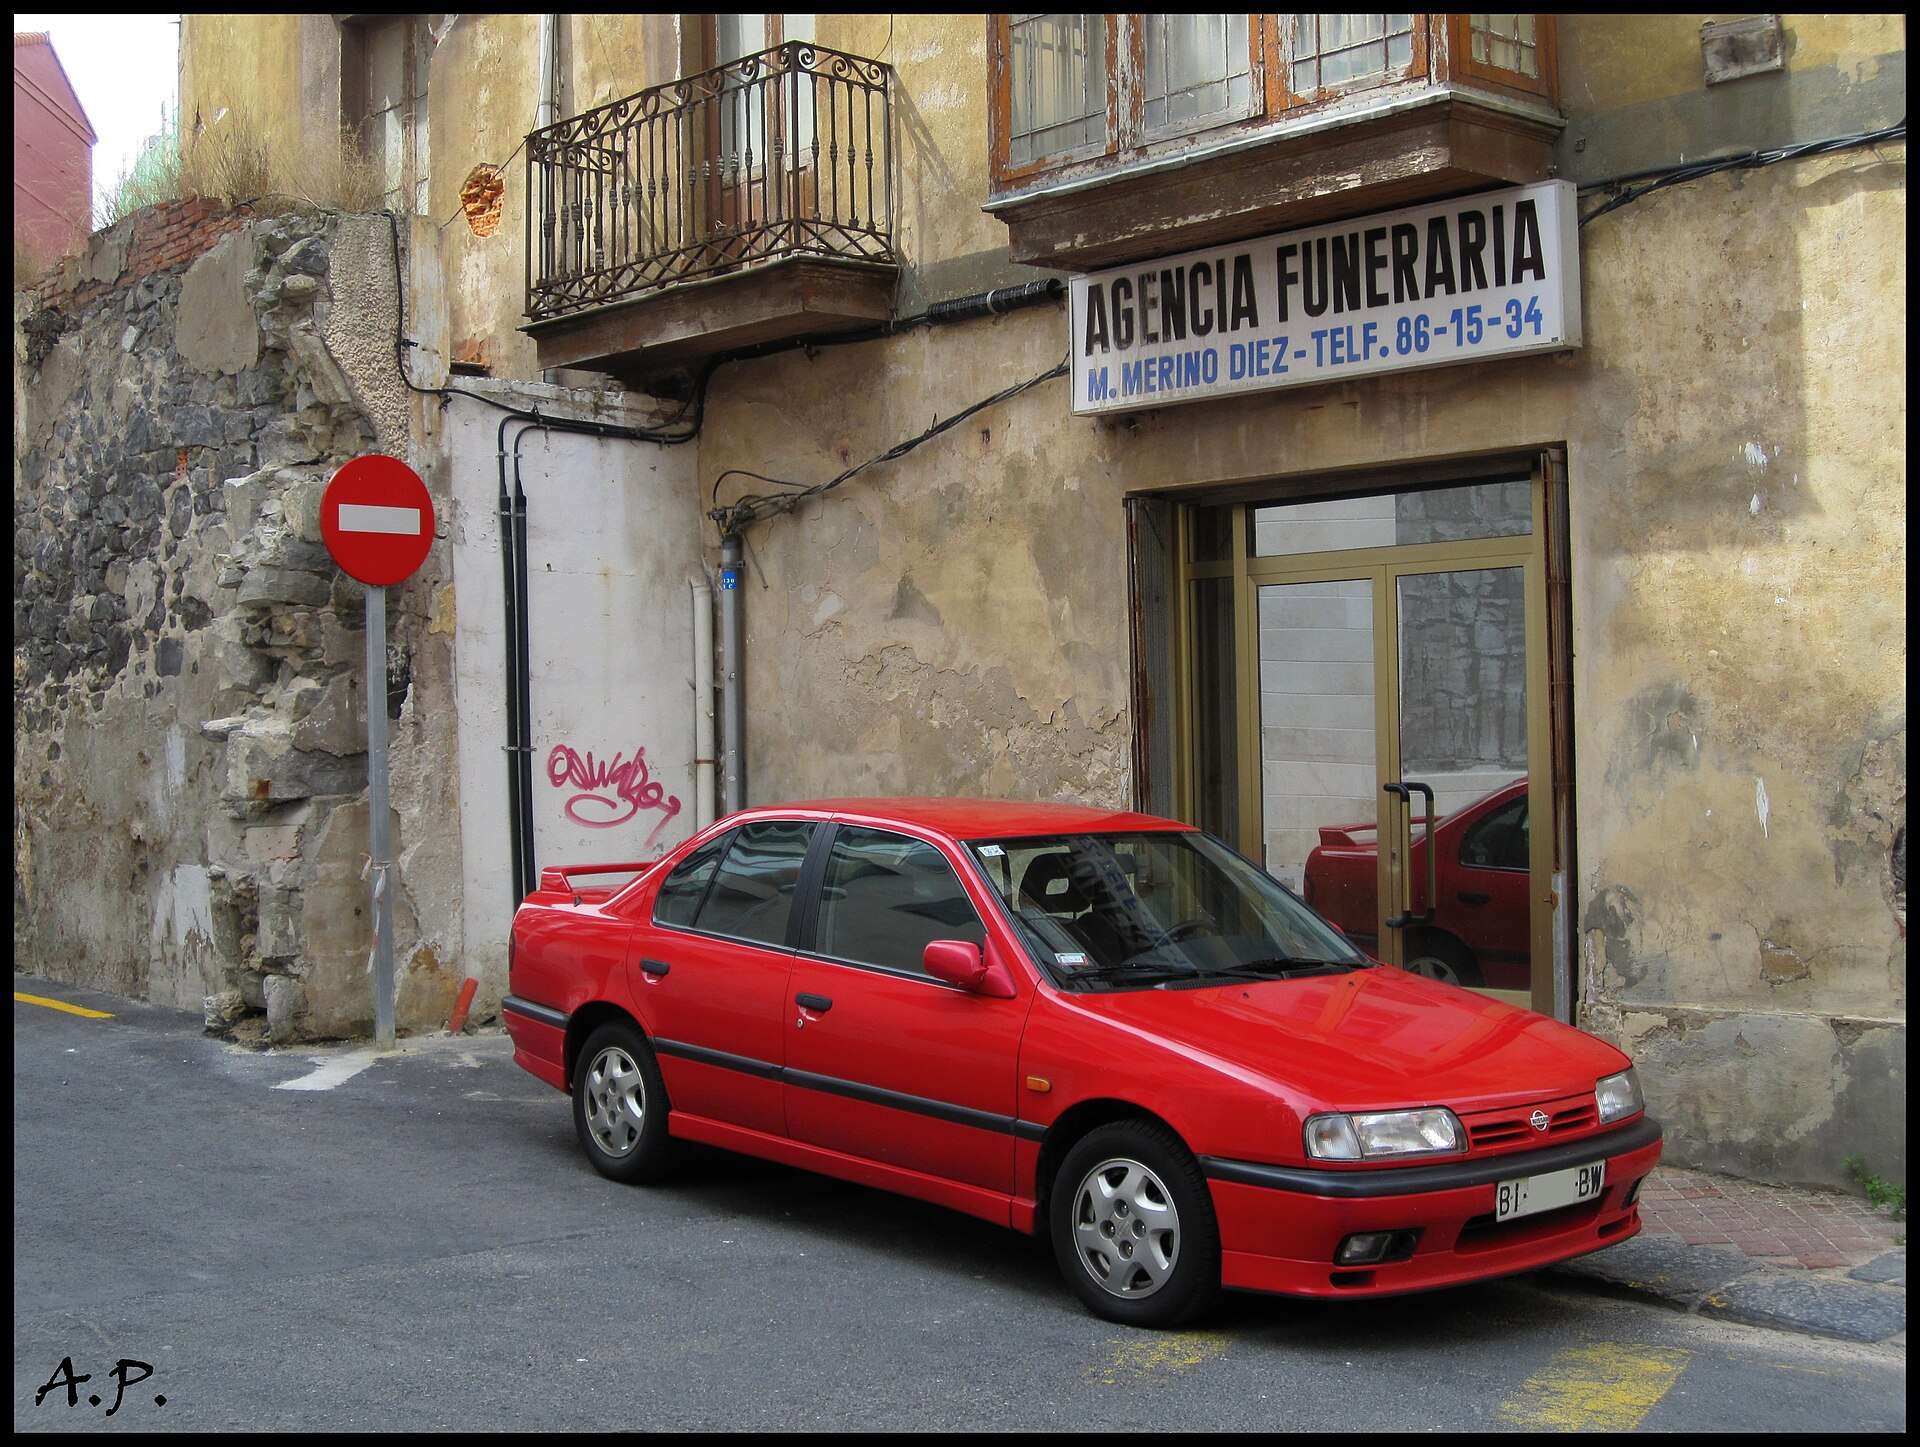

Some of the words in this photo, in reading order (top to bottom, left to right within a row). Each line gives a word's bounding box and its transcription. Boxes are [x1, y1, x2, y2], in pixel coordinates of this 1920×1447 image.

[1085, 253, 1259, 357] AGENCIA
[1276, 199, 1546, 323] FUNERARIA
[1088, 367, 1117, 401] M.
[1122, 348, 1218, 396] MERINO
[1396, 295, 1543, 356] 86-15-34
